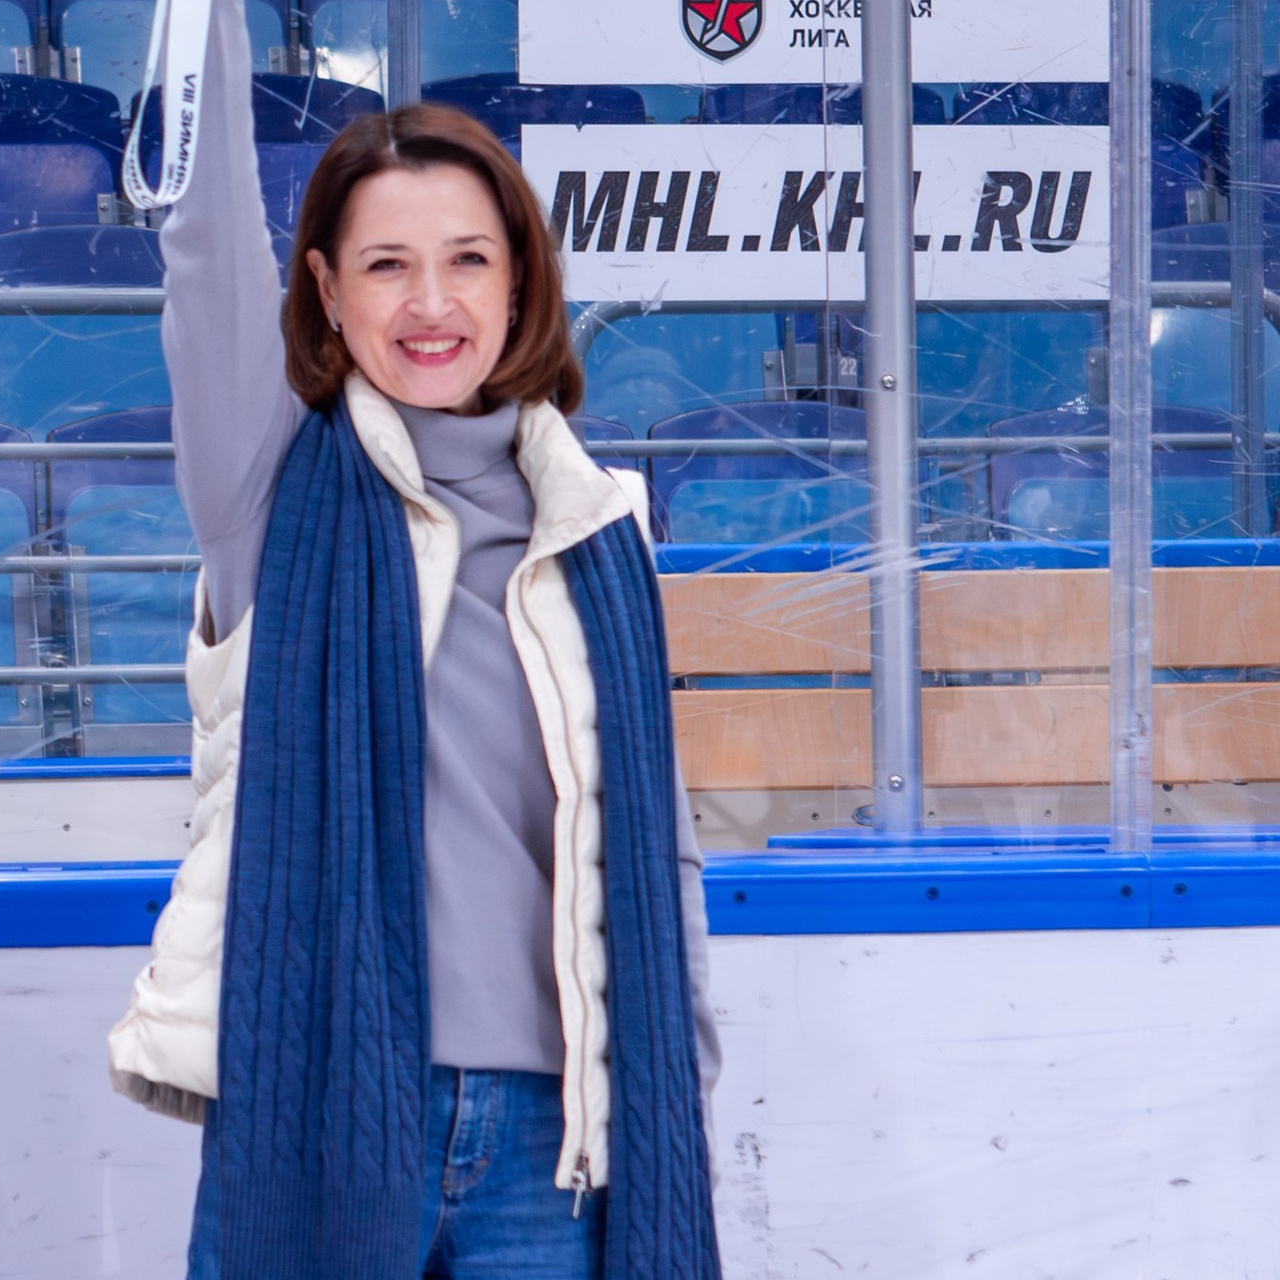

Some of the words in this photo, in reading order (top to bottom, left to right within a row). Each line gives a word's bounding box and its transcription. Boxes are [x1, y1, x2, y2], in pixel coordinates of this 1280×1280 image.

[789, 0, 932, 19] ХОККЕЯ
[789, 29, 851, 48] ЛИГА
[840, 357, 857, 376] 22
